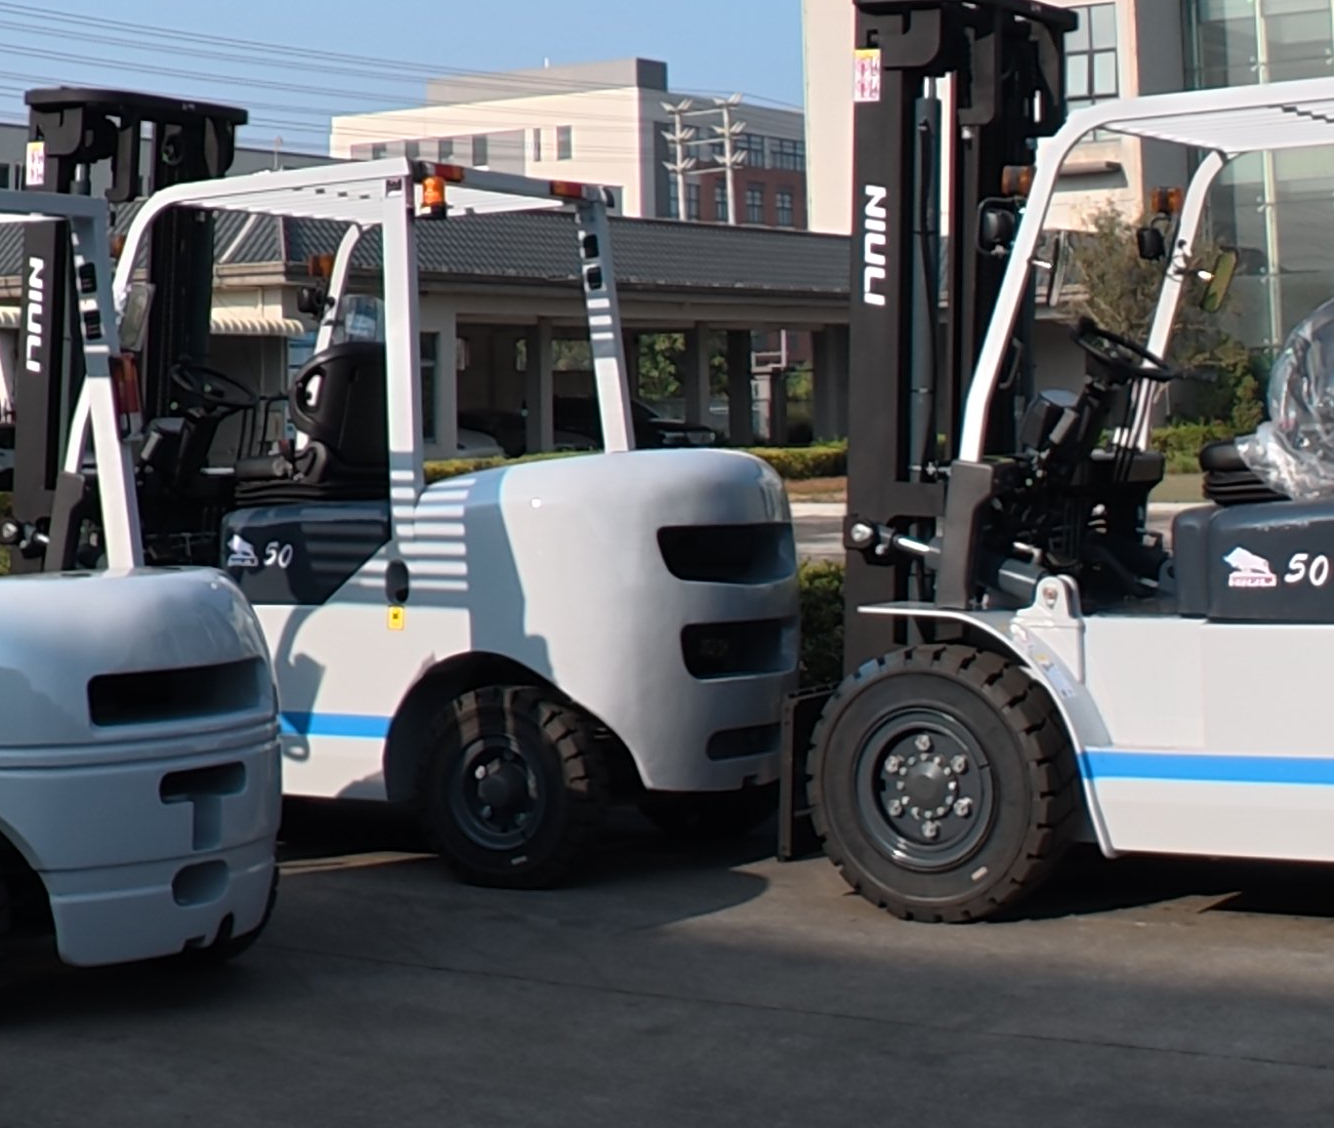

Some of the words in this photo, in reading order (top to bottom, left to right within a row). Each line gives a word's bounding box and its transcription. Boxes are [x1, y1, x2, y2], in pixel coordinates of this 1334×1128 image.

[864, 184, 887, 306] NIULI
[26, 256, 45, 373] NIULI
[264, 540, 293, 568] 50
[1284, 552, 1329, 586] 50
